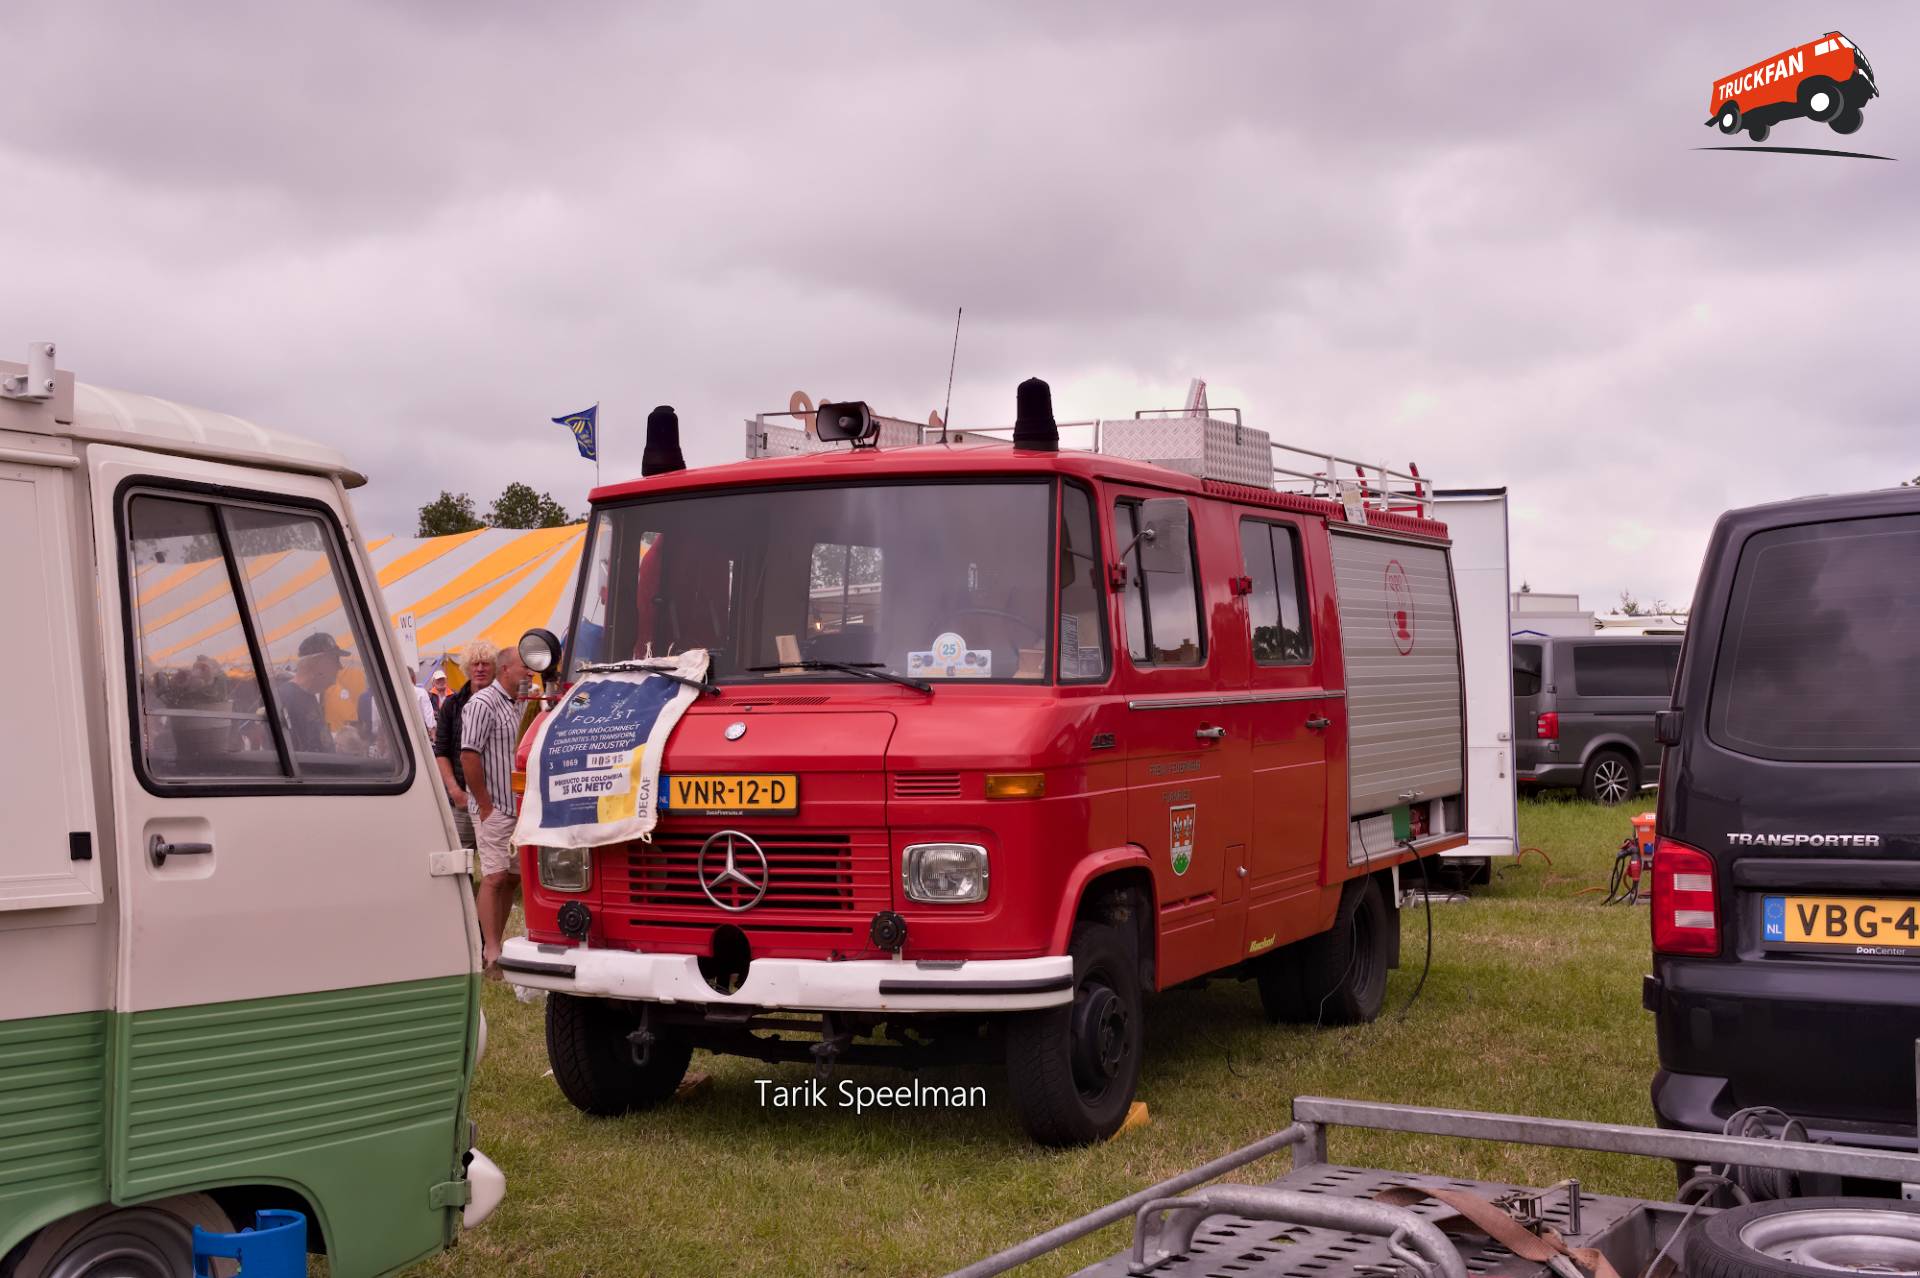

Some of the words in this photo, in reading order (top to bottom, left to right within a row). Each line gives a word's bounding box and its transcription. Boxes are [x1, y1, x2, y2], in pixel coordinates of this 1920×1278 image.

[400, 615, 413, 629] WC
[942, 643, 957, 655] 25
[570, 708, 636, 724] FOREST
[548, 747, 561, 755] THE
[562, 743, 588, 753] COFFEE
[571, 783, 583, 794] KG
[585, 781, 613, 792] NETO
[678, 780, 786, 805] VNR-12-D
[639, 776, 651, 818] DECAF
[1726, 832, 1880, 847] TRANSPORTER
[1766, 924, 1782, 935] NL
[1856, 946, 1906, 956] PonCenter
